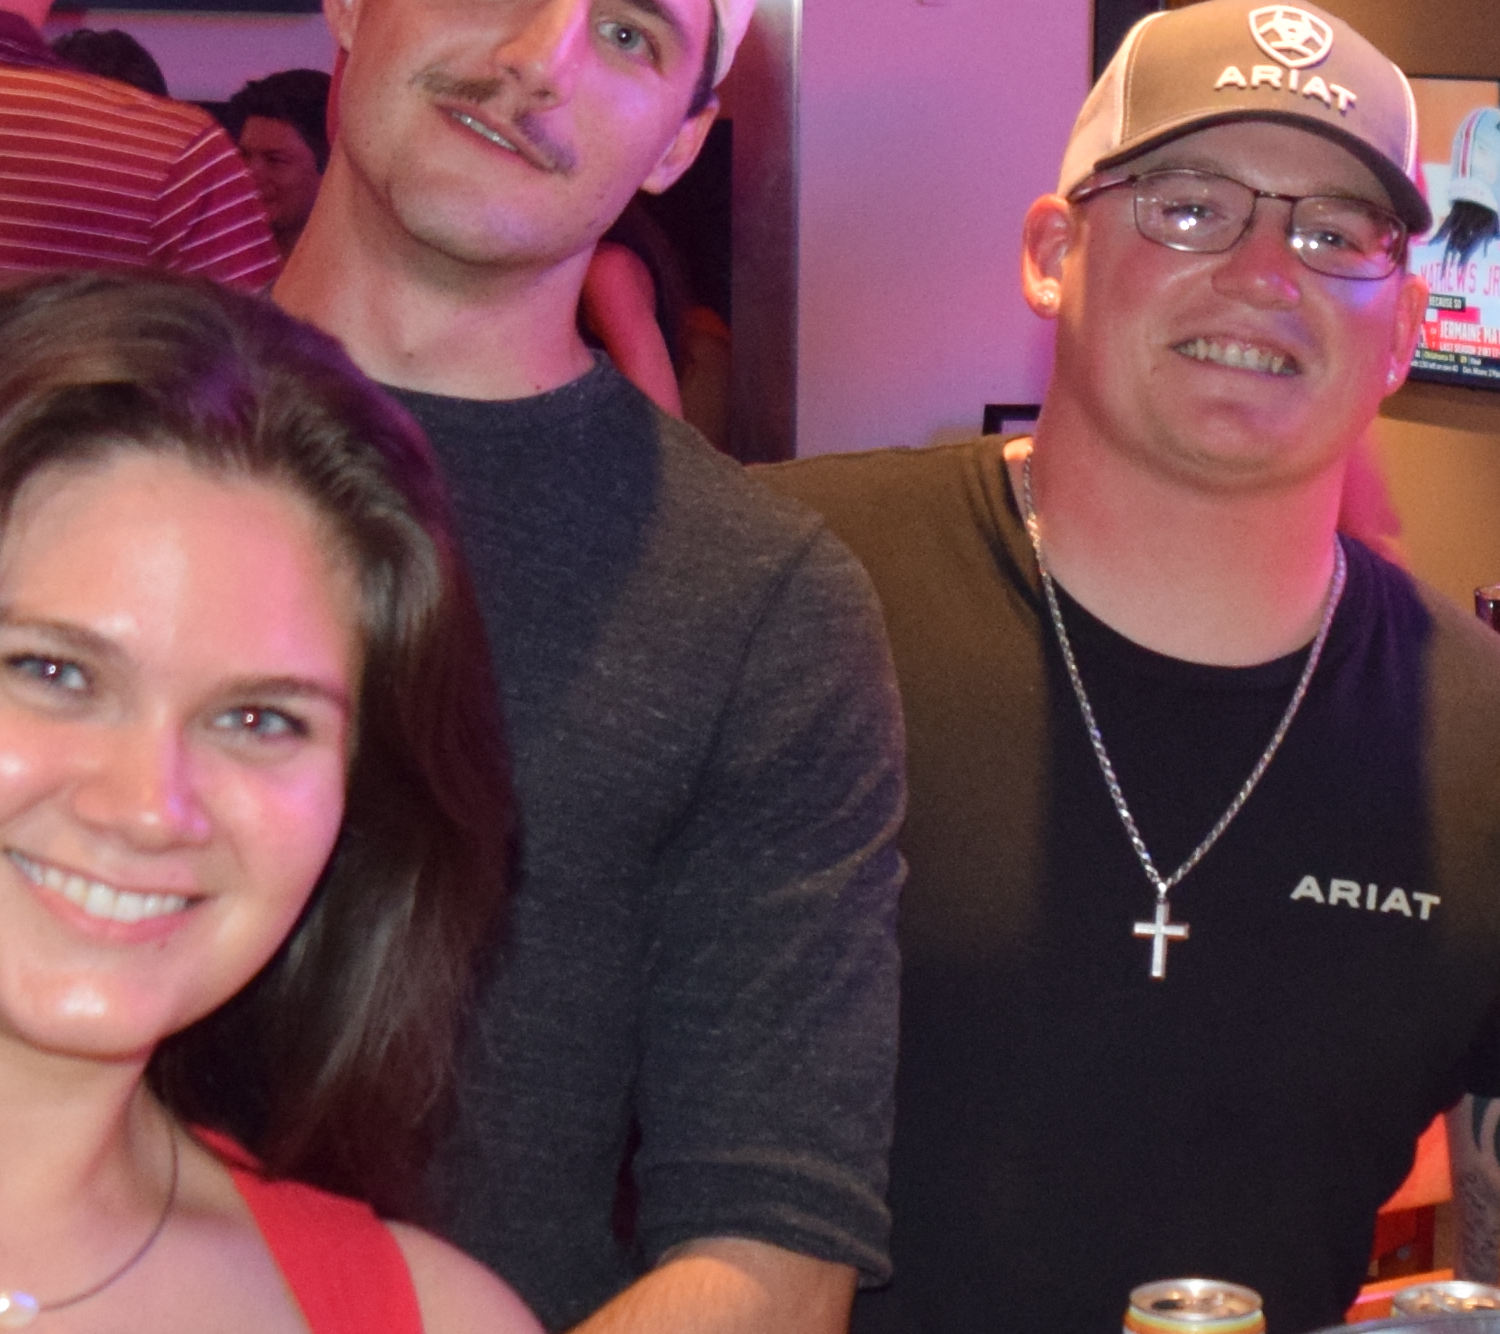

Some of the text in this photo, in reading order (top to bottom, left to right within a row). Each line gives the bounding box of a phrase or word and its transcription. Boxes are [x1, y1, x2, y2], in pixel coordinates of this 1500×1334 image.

[1214, 64, 1358, 114] ARIAT
[1440, 320, 1482, 342] JERMAINE
[1289, 874, 1441, 921] ARIAT
